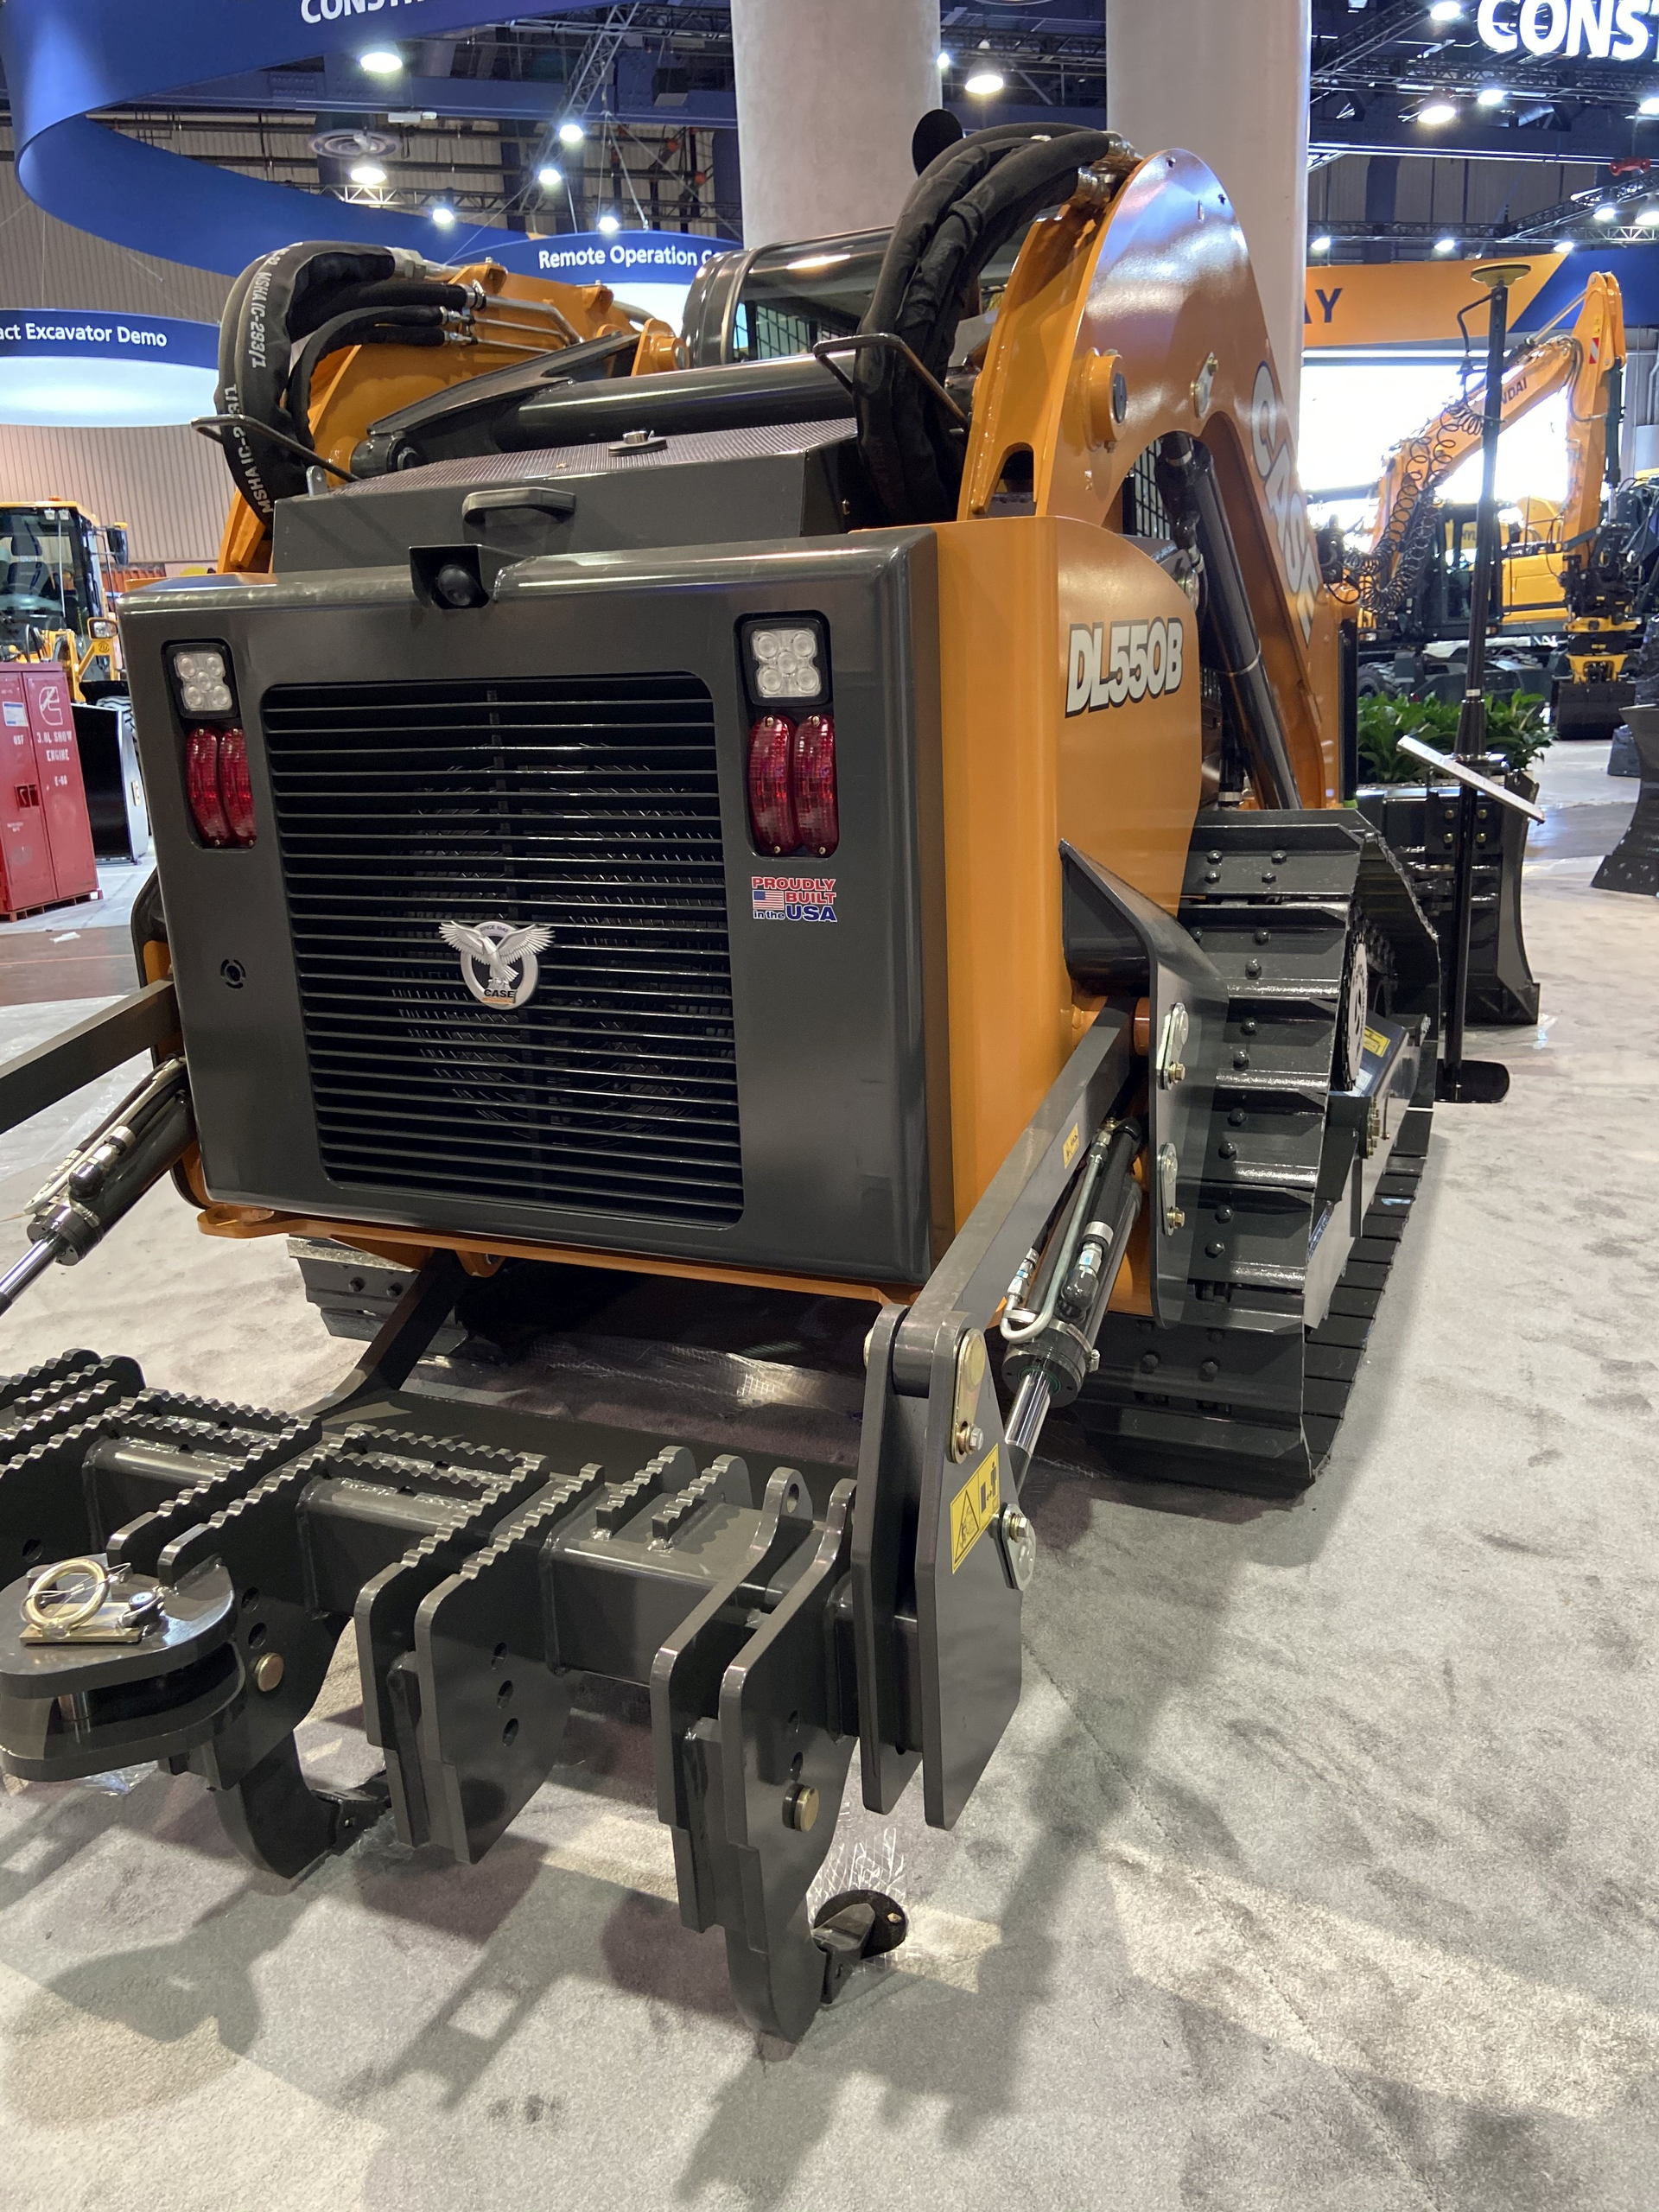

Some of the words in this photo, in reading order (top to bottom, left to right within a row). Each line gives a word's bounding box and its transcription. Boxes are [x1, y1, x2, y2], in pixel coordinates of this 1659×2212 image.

[1477, 0, 1659, 61] CONS
[538, 246, 606, 270] Remote
[610, 245, 698, 267] Operation
[251, 271, 273, 302] MSHA
[1304, 288, 1344, 325] Y
[25, 323, 113, 342] Excavator
[117, 326, 168, 347] Demo
[248, 302, 267, 368] IC-293/1
[224, 384, 254, 465] IC-23/1
[244, 465, 274, 514] MSHA
[1251, 359, 1320, 648] CASE
[1065, 616, 1184, 719] DL550B
[54, 730, 73, 743] SHOW
[46, 748, 70, 761] ENGINE
[751, 876, 836, 892] PROUDLY
[784, 890, 837, 905] BUILT
[753, 910, 765, 919] in
[766, 910, 785, 920] the
[785, 904, 838, 922] USA
[483, 988, 516, 998] CASE
